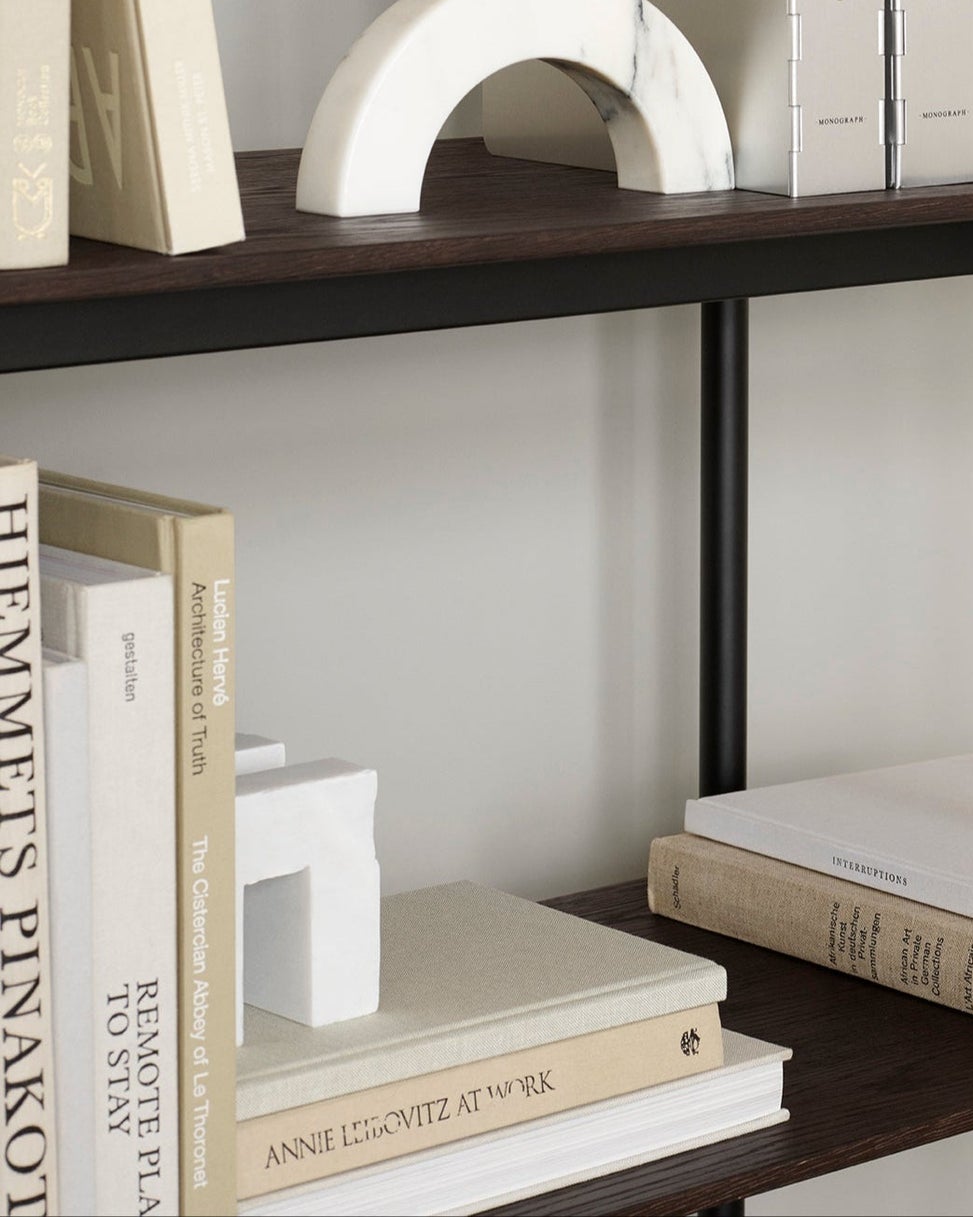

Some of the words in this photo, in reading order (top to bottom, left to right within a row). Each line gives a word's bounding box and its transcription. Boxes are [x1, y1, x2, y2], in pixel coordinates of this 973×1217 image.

[213, 579, 230, 642] Lucien
[191, 582, 207, 697] Architecture
[121, 632, 136, 703] gestalten
[213, 647, 230, 706] Hervé
[192, 702, 206, 721] of
[192, 724, 207, 776] Truth
[192, 835, 208, 874] The
[831, 855, 908, 887] INTERRUPTIONS
[192, 879, 208, 975] Cistercian
[828, 902, 840, 965] Afrikanische
[838, 921, 847, 953] Kunst
[848, 906, 860, 961] deutschen
[902, 928, 912, 945] Art
[910, 935, 922, 971] Private
[900, 948, 909, 985] African
[910, 975, 919, 985] in
[921, 942, 931, 986] German
[931, 937, 944, 996] Collections
[107, 983, 130, 1036] TO
[190, 979, 209, 1041] Abbey
[136, 977, 160, 1139] REMOTE
[193, 1046, 208, 1065] of
[107, 1049, 131, 1136] STAY
[193, 1072, 208, 1097] Le
[193, 1100, 208, 1190] Thoronet
[264, 1128, 336, 1170] ANNIE
[341, 1097, 451, 1148] LEIBOVITZ
[456, 1088, 482, 1117] AT
[486, 1069, 556, 1100] WORK
[138, 1146, 160, 1216] PLA
